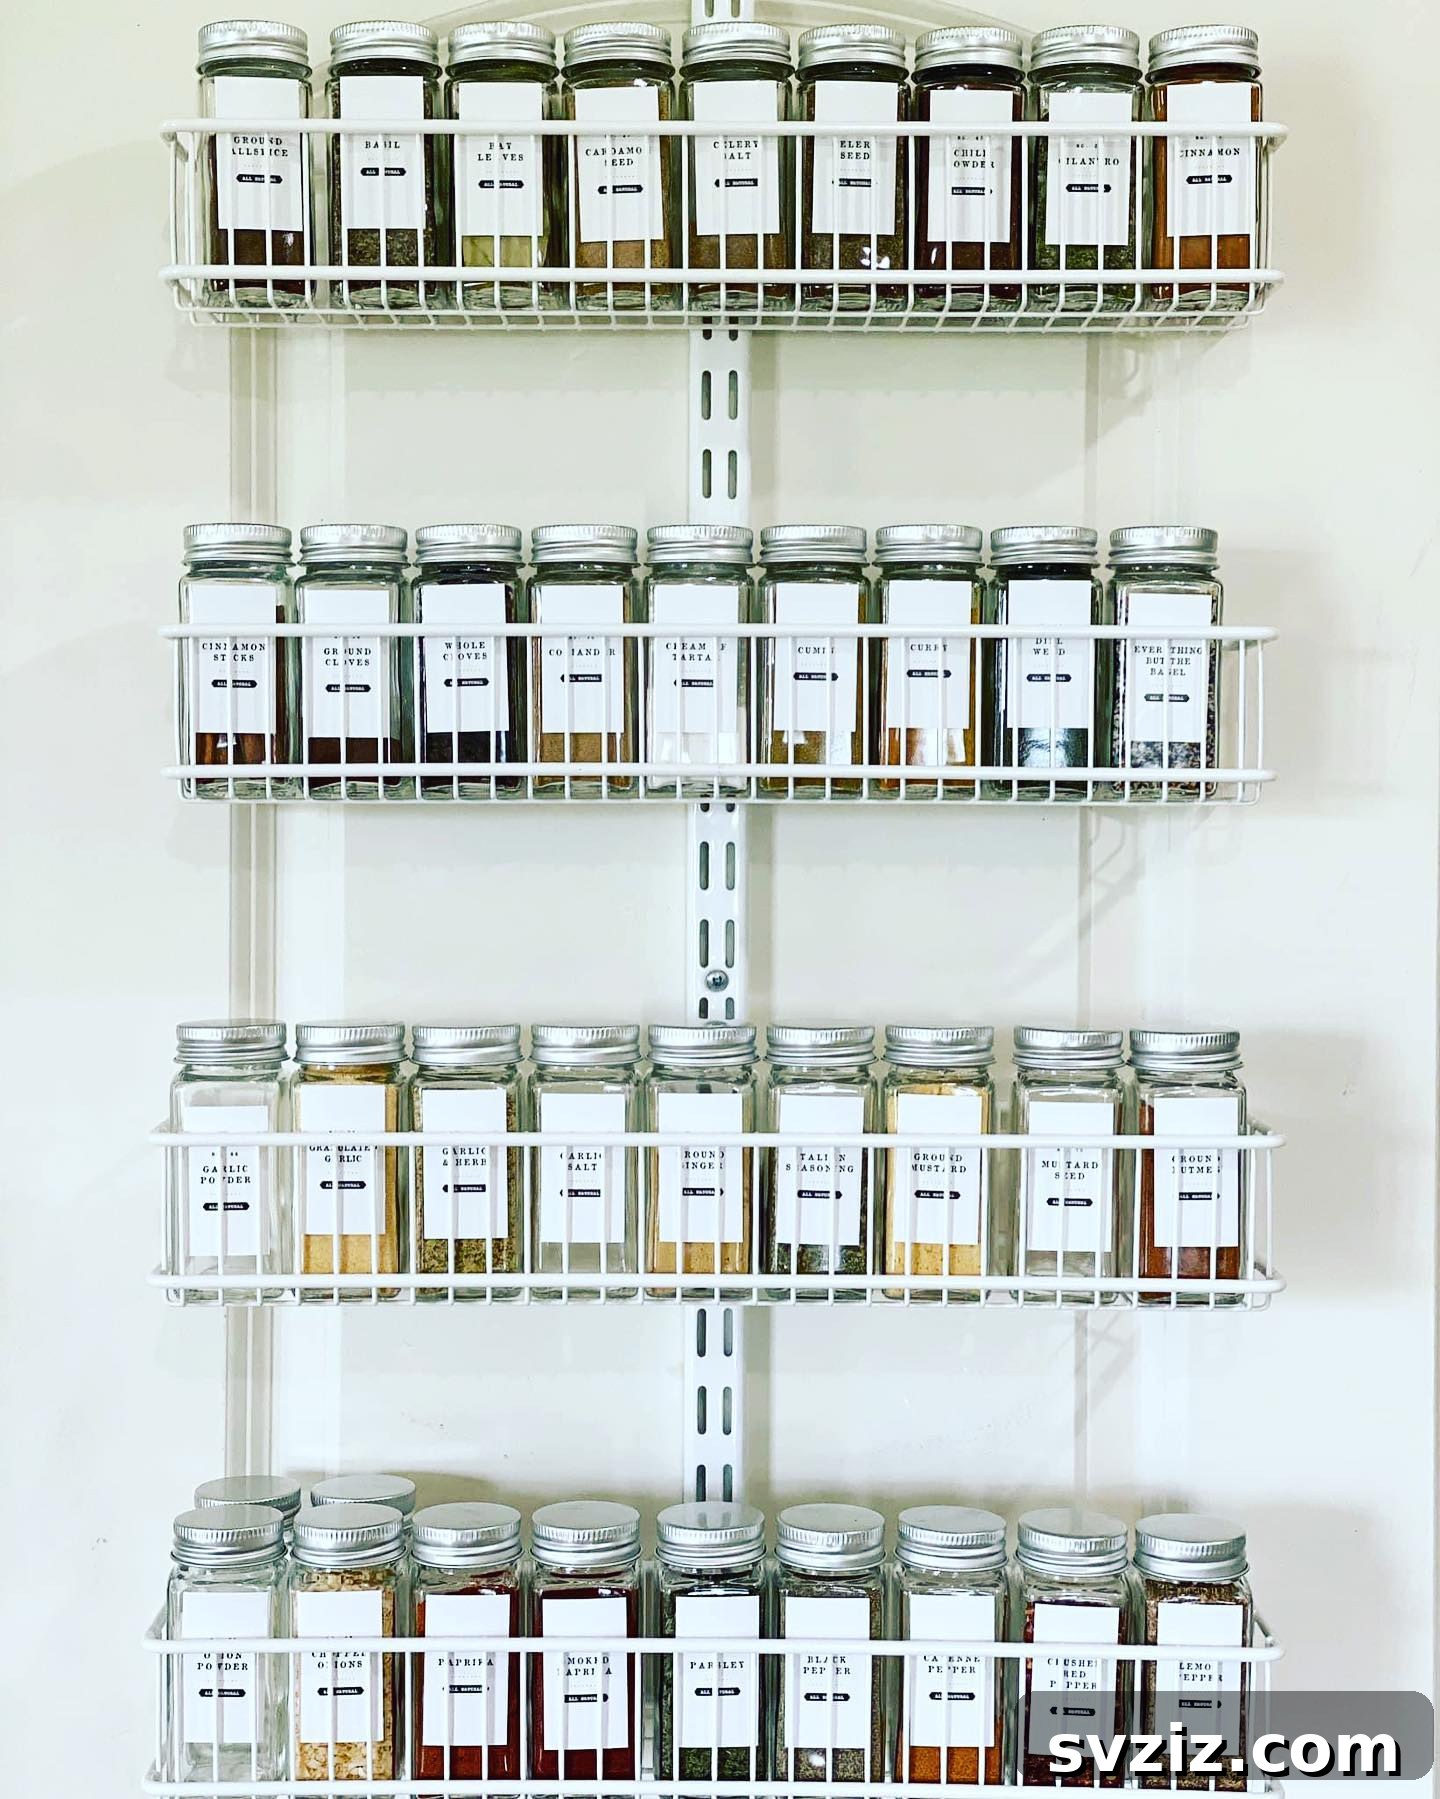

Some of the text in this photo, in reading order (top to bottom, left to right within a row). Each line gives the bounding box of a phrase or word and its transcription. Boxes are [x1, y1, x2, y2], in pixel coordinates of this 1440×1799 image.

[840, 140, 871, 149] ELER
[477, 153, 525, 162] LEVES
[724, 151, 751, 160] ALT
[604, 158, 634, 167] EED
[324, 647, 372, 656] GRUND
[548, 648, 616, 657] COIANDR
[1033, 648, 1066, 656] WED
[1133, 645, 1204, 655] EVERTHING
[213, 654, 255, 662] STCKS
[443, 652, 489, 661] COVES
[325, 658, 371, 667] CLVES
[324, 1155, 362, 1163] GRLIC
[800, 1153, 846, 1162] TALIN
[785, 1163, 855, 1174] SASONNG
[1041, 1160, 1099, 1169] MUTARD
[200, 1176, 251, 1185] PODER
[317, 1660, 363, 1669] OIONS
[1179, 1661, 1211, 1671] LEMO
[803, 1666, 851, 1675] PEPER
[1049, 1680, 1098, 1690] PPPER
